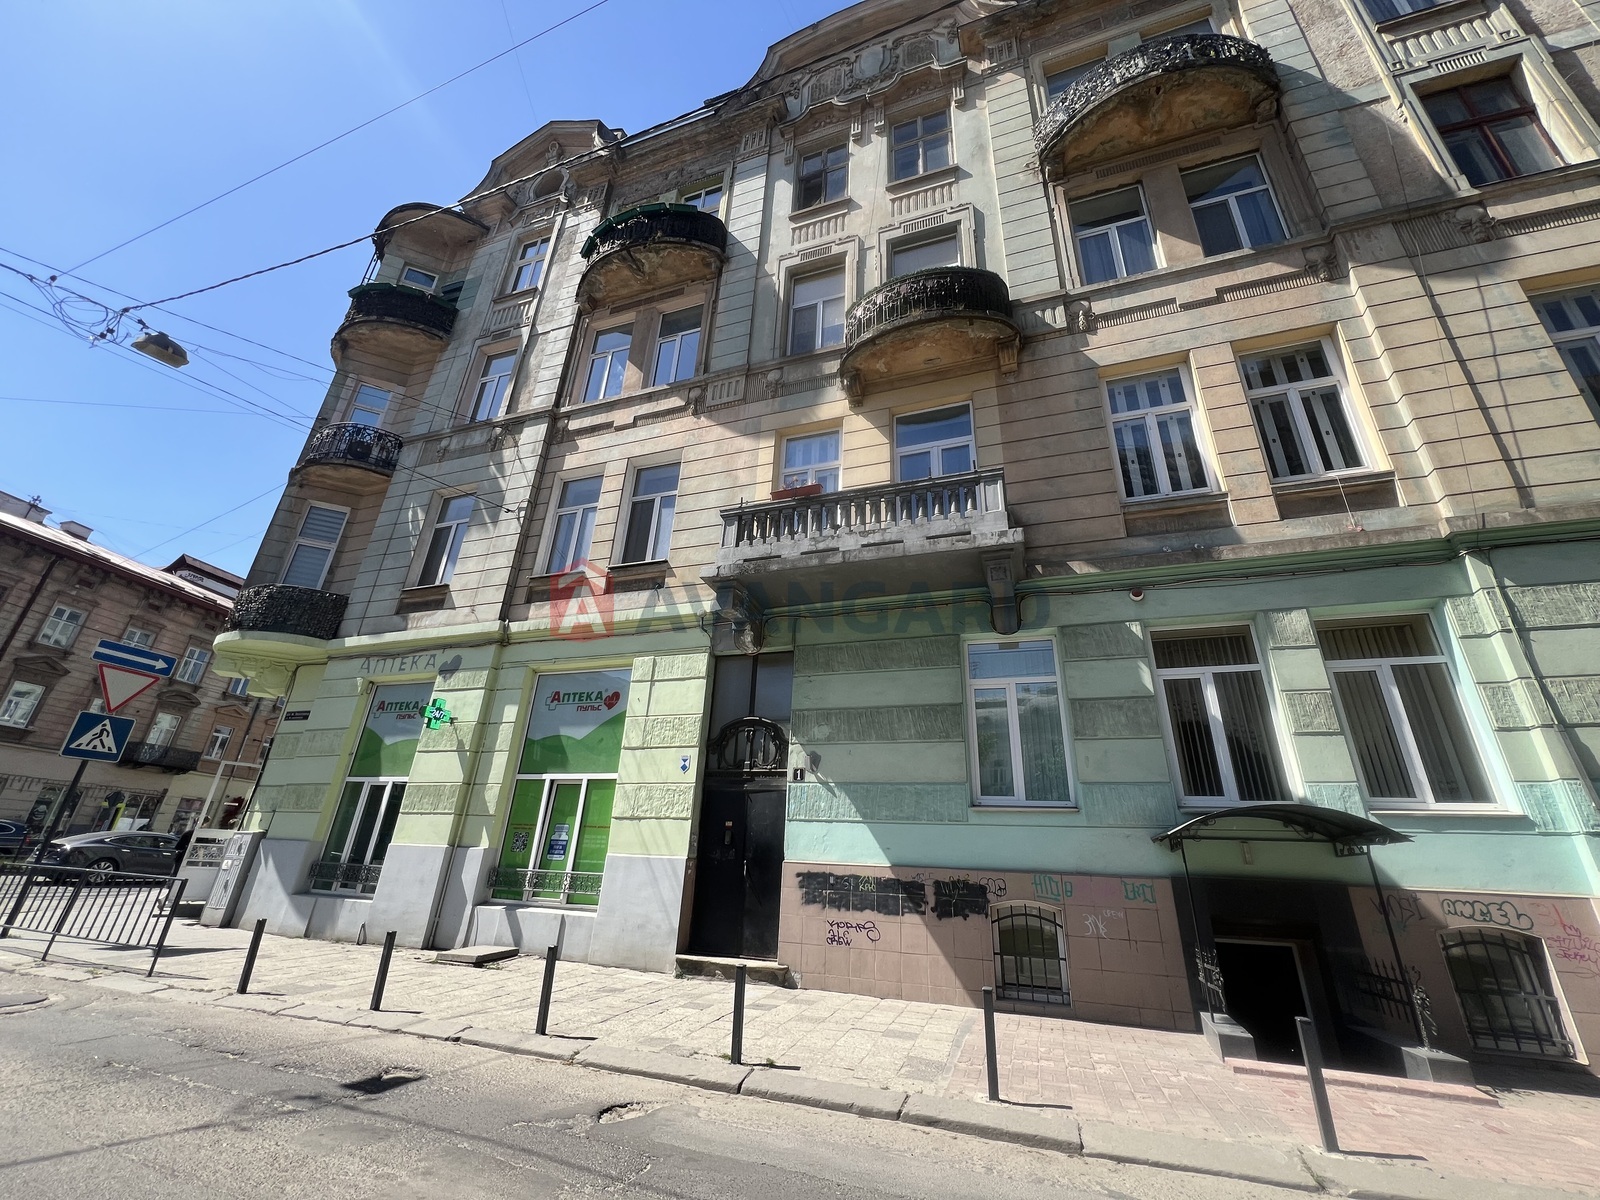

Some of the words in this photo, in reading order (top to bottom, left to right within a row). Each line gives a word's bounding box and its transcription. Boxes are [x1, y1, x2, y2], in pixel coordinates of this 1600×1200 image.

[359, 653, 437, 674] АПТЕКА
[550, 690, 604, 704] АПТЕКА
[376, 700, 420, 712] АПТЕКА
[576, 704, 603, 712] ПУЛЬС
